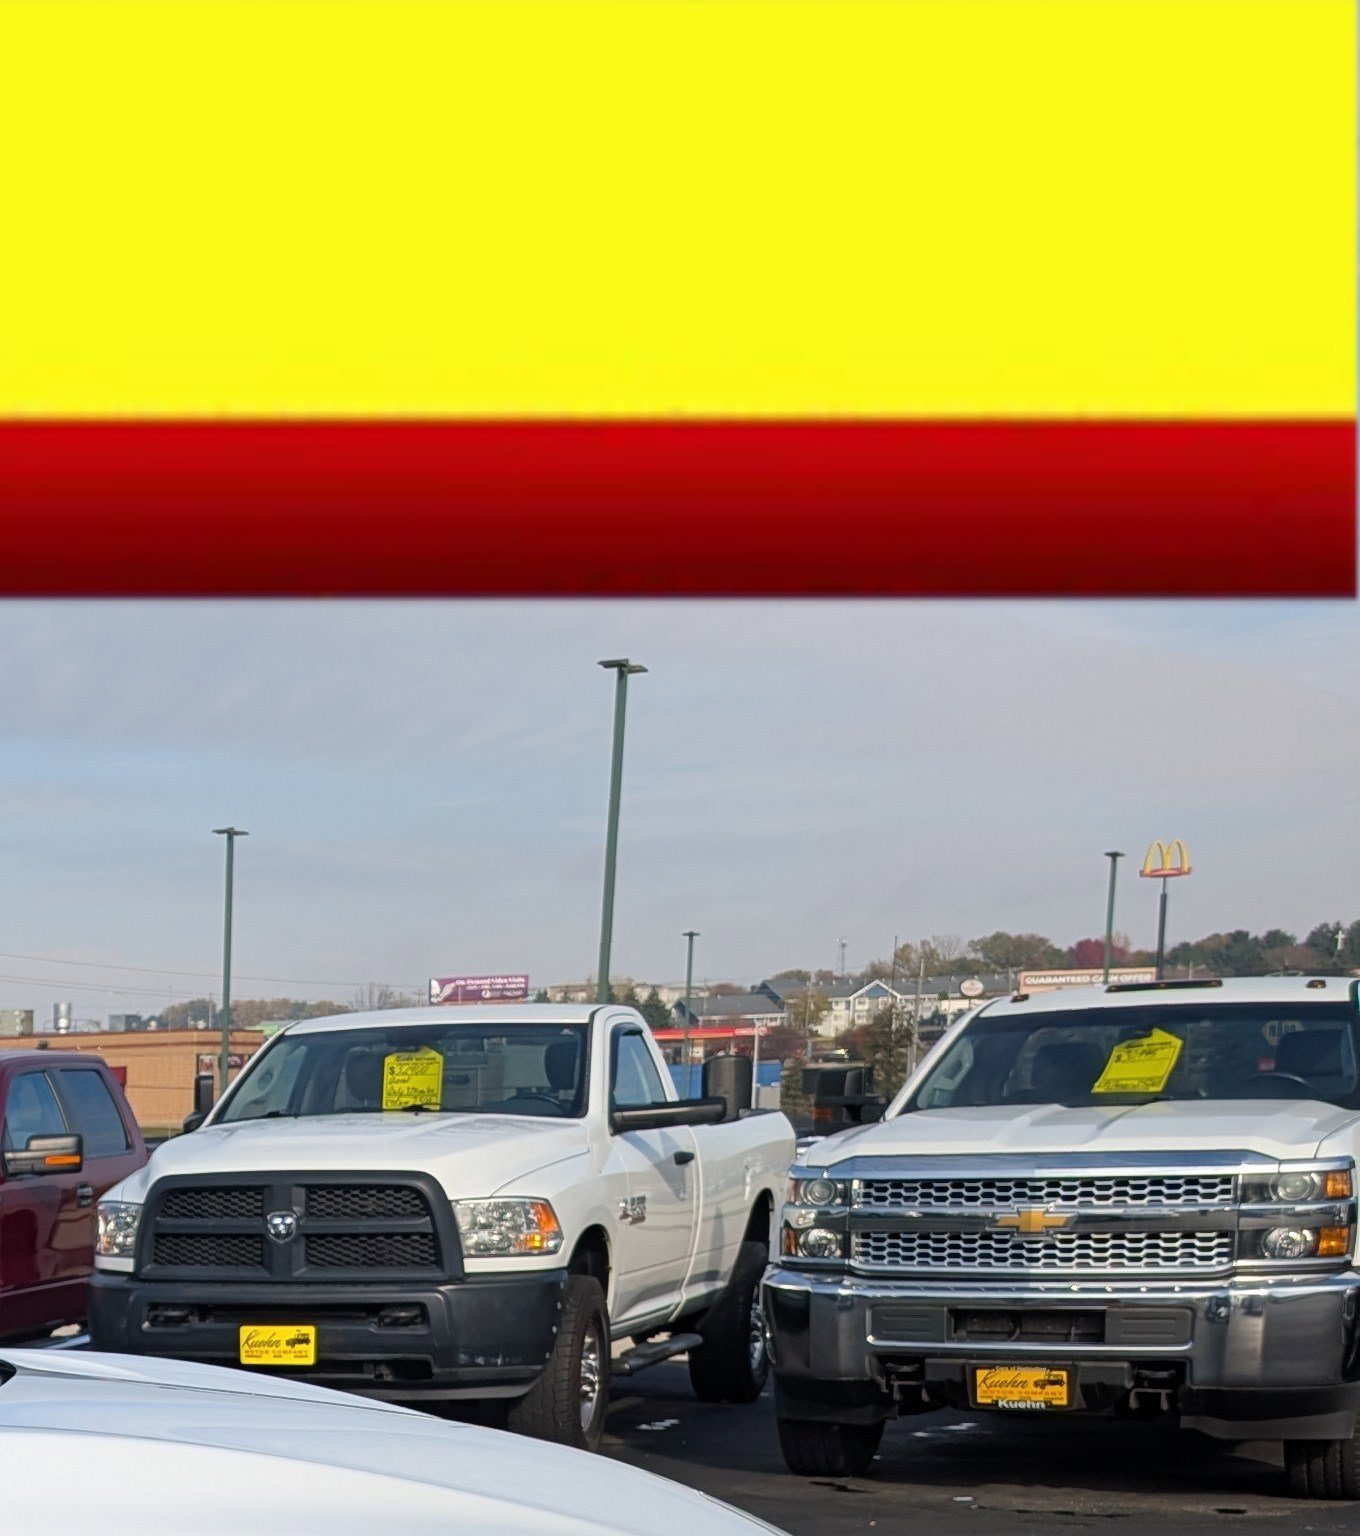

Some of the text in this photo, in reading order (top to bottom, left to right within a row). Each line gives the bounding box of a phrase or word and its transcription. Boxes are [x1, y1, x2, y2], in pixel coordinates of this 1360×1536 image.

[1025, 974, 1090, 985] GUARANTEED
[1091, 974, 1120, 983] CAH
[242, 1330, 281, 1349] Kuehn
[978, 1369, 1028, 1389] Kuehn
[998, 1398, 1047, 1409] Kuehn
